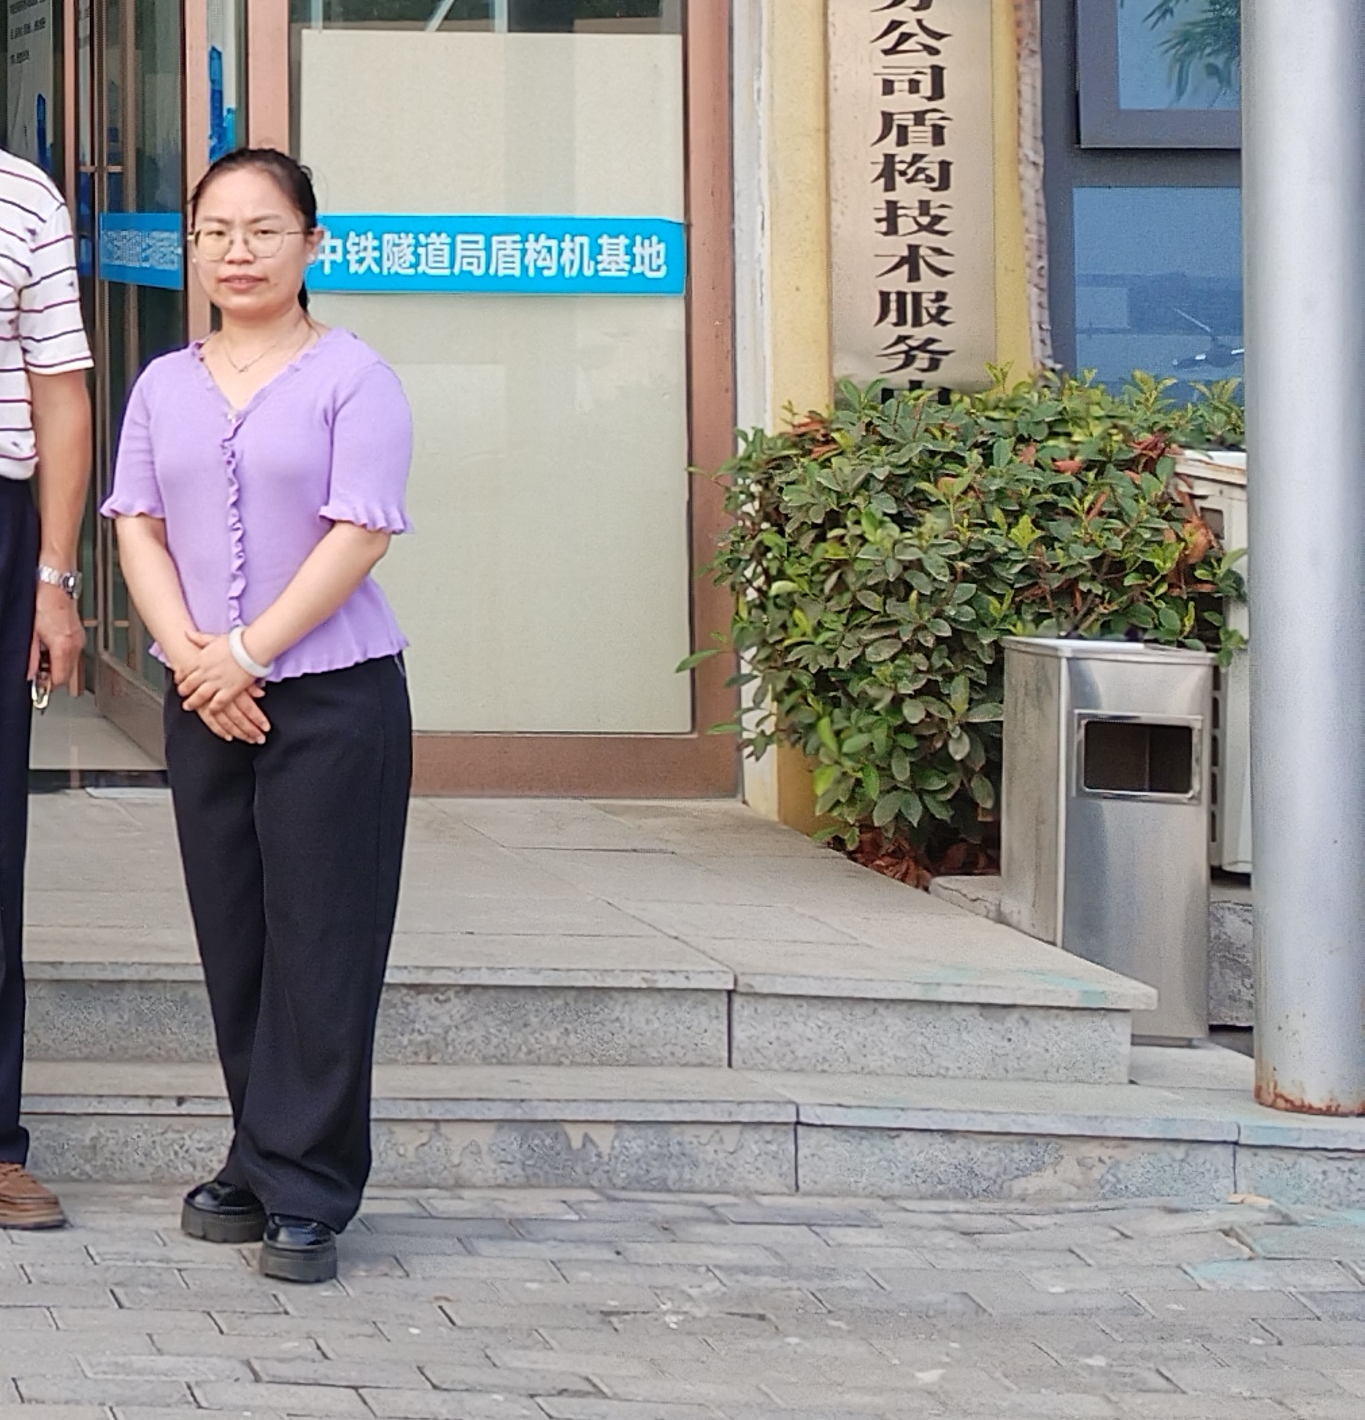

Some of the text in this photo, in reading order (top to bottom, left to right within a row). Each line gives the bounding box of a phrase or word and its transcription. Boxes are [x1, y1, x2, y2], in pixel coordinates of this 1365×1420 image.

[317, 230, 668, 279] 中铁隧道局盾构机基地
